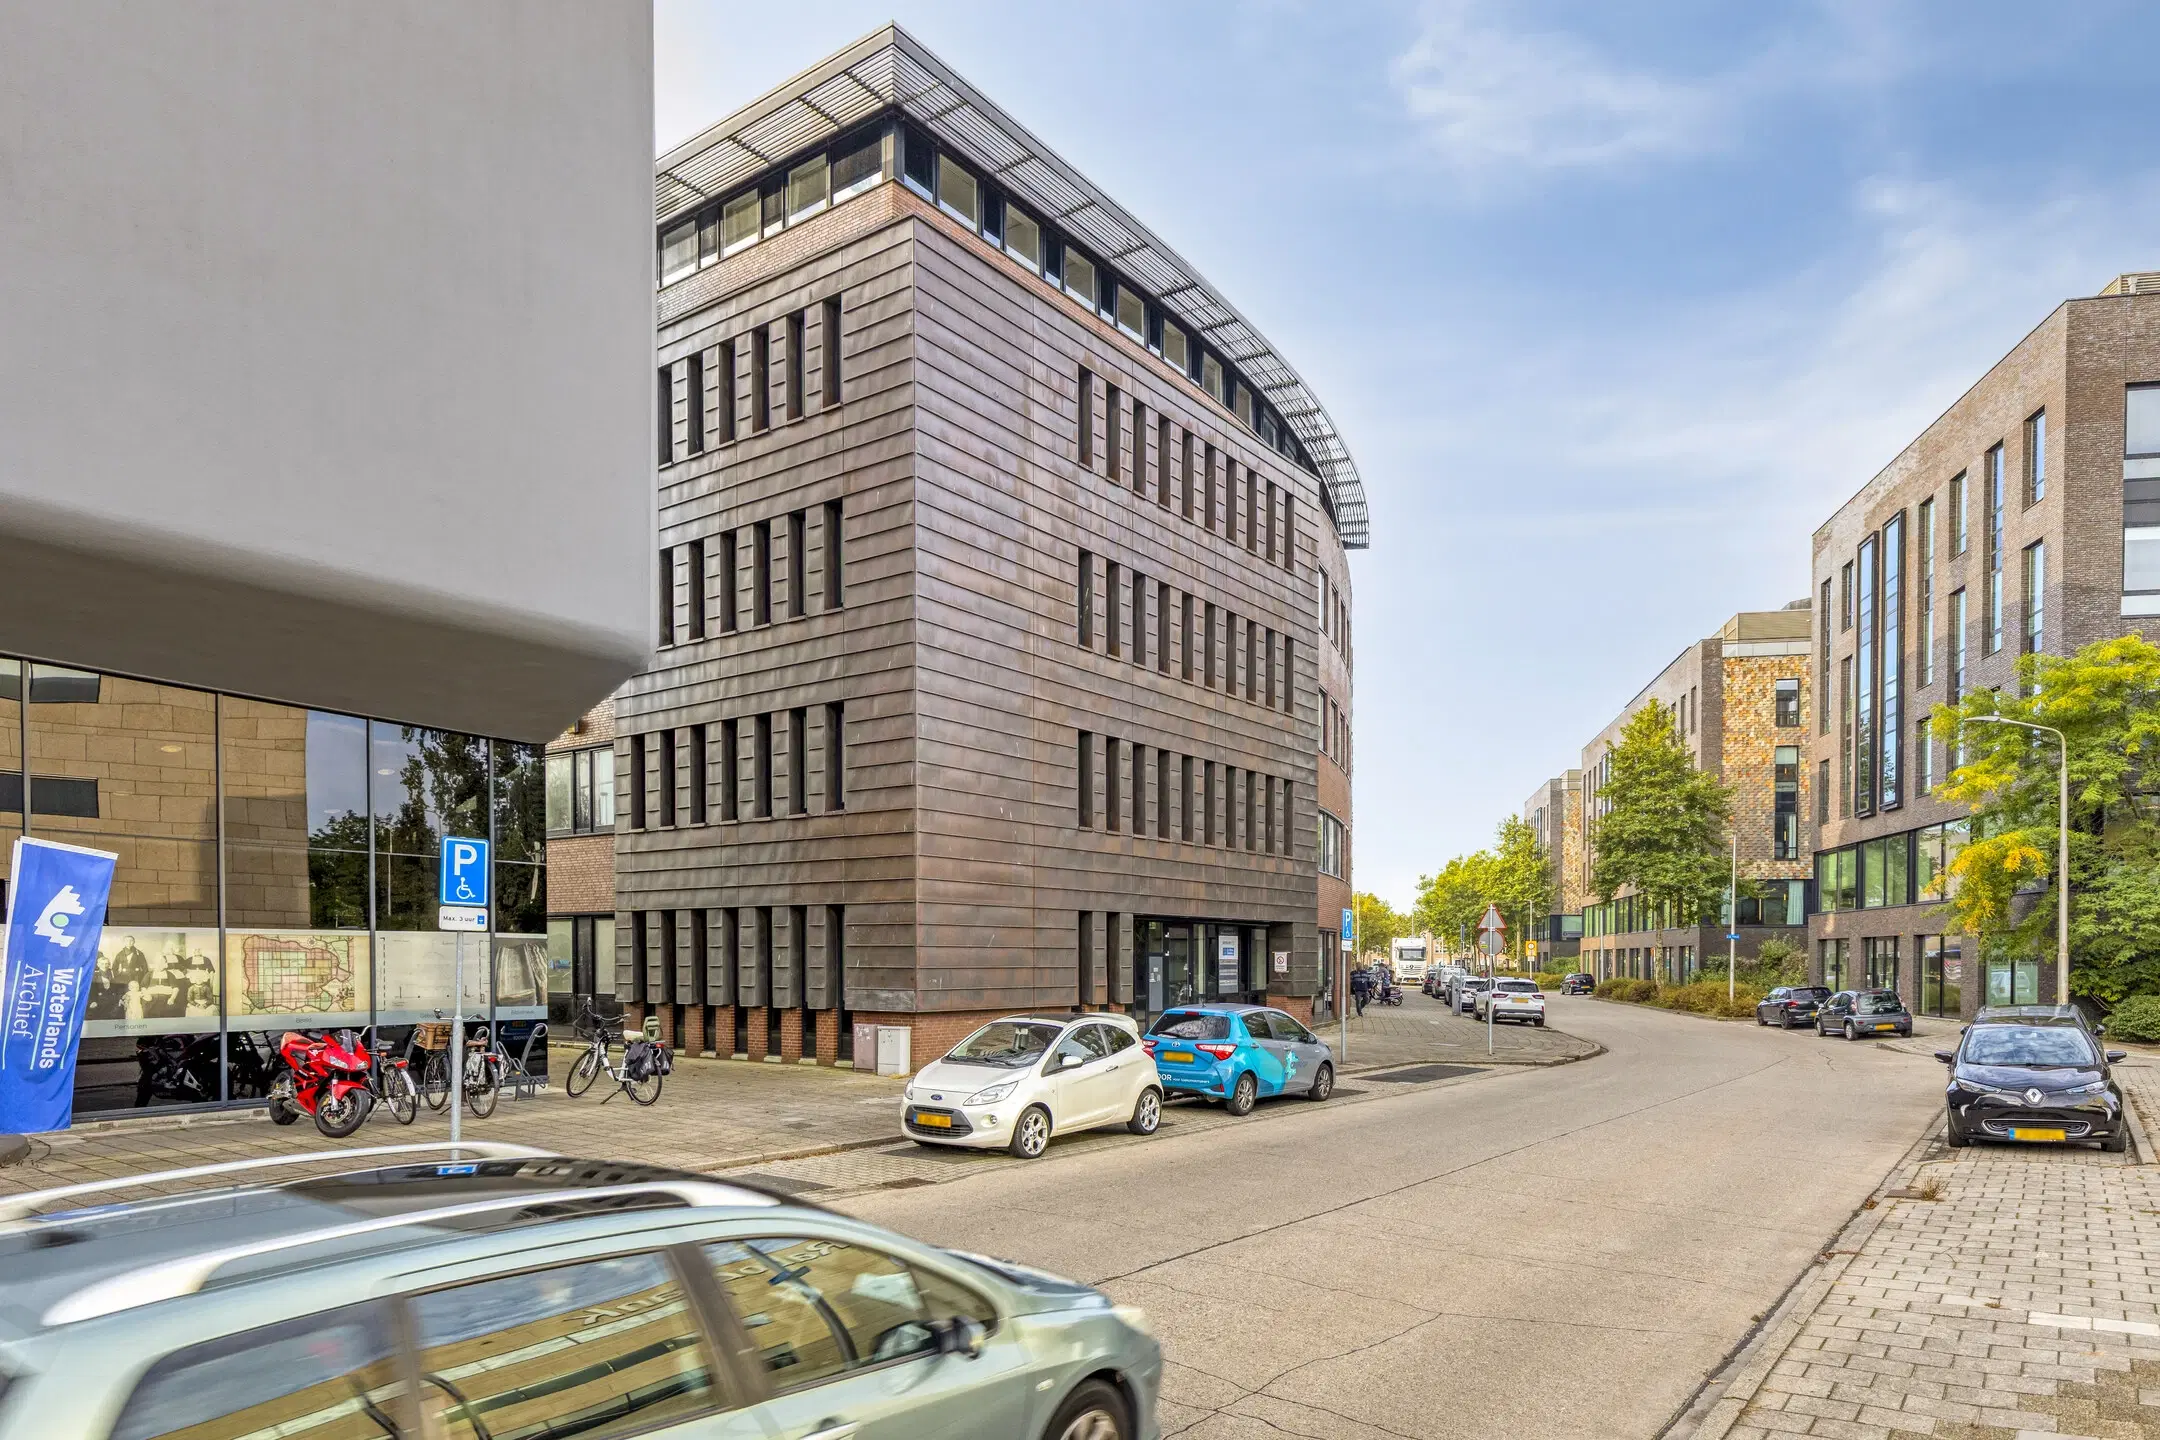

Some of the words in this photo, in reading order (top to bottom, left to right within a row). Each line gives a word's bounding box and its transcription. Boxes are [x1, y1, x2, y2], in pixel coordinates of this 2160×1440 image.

[454, 843, 478, 876] P
[1345, 911, 1351, 927] P
[12, 963, 45, 1040] Archief
[39, 968, 75, 1069] Waterlands
